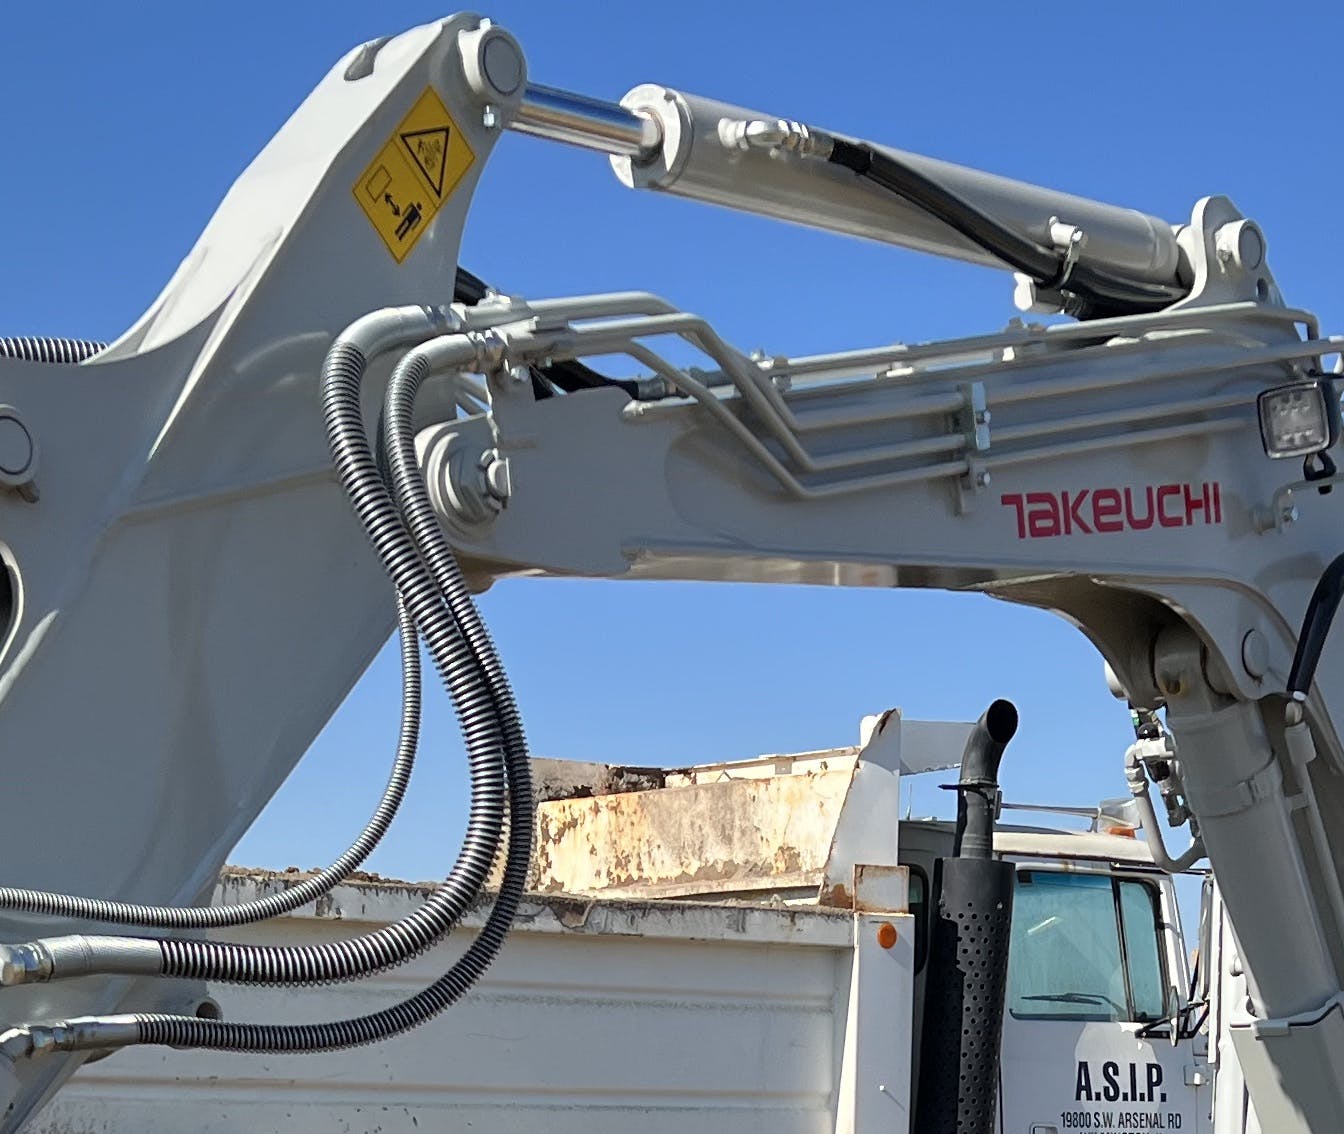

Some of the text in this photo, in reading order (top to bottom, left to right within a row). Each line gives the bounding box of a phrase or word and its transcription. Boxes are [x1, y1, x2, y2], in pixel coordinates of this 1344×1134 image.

[1075, 1061, 1167, 1102] A.S.I.P.
[1060, 1112, 1182, 1129] 19800 S.W. ARSENAL RD
